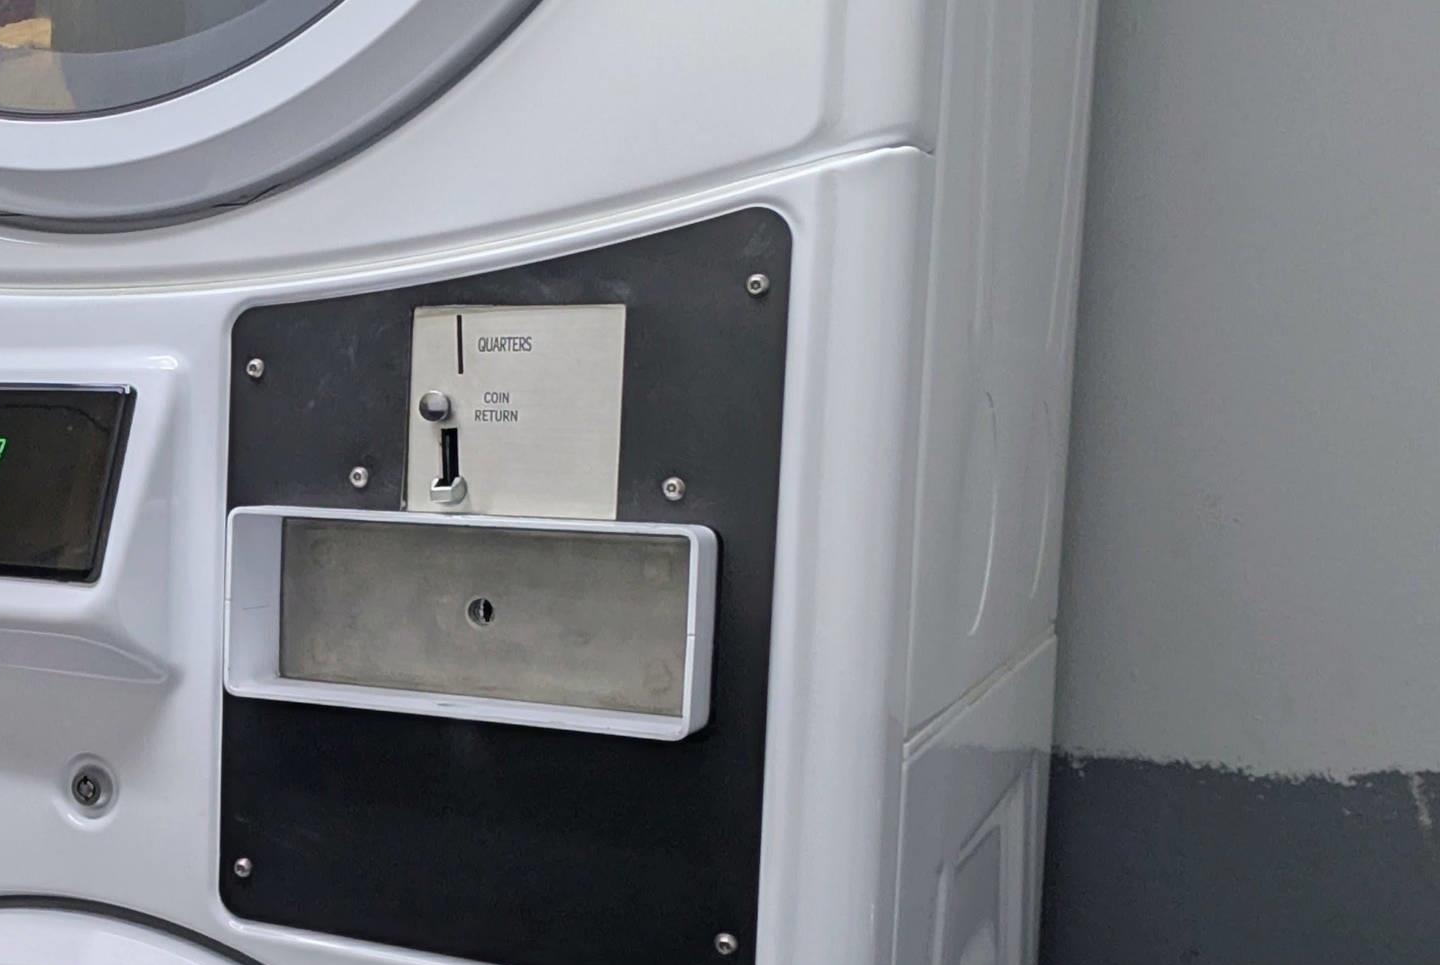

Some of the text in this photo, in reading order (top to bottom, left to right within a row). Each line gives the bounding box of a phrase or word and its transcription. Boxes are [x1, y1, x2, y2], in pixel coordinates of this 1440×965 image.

[478, 336, 532, 352] QUARTERS
[483, 391, 510, 404] COIN
[474, 409, 518, 422] RETURN
